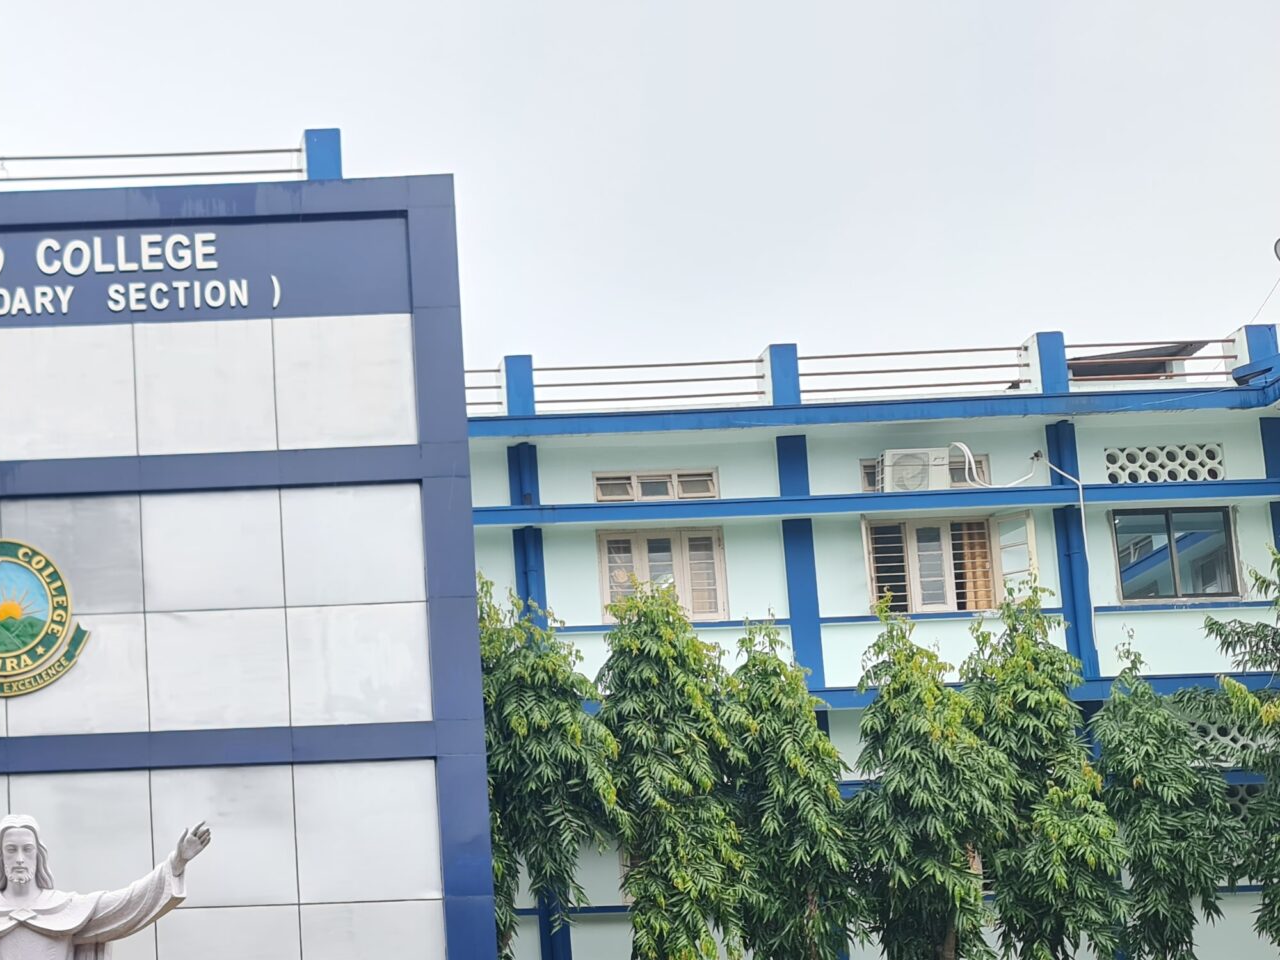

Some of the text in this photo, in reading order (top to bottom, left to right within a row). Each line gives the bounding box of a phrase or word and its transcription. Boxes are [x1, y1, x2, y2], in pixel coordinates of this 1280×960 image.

[36, 232, 218, 275] COLLEGE
[107, 278, 248, 312] SECTION
[18, 547, 67, 638] COLLEGE
[4, 656, 69, 694] EXCELLENCE
